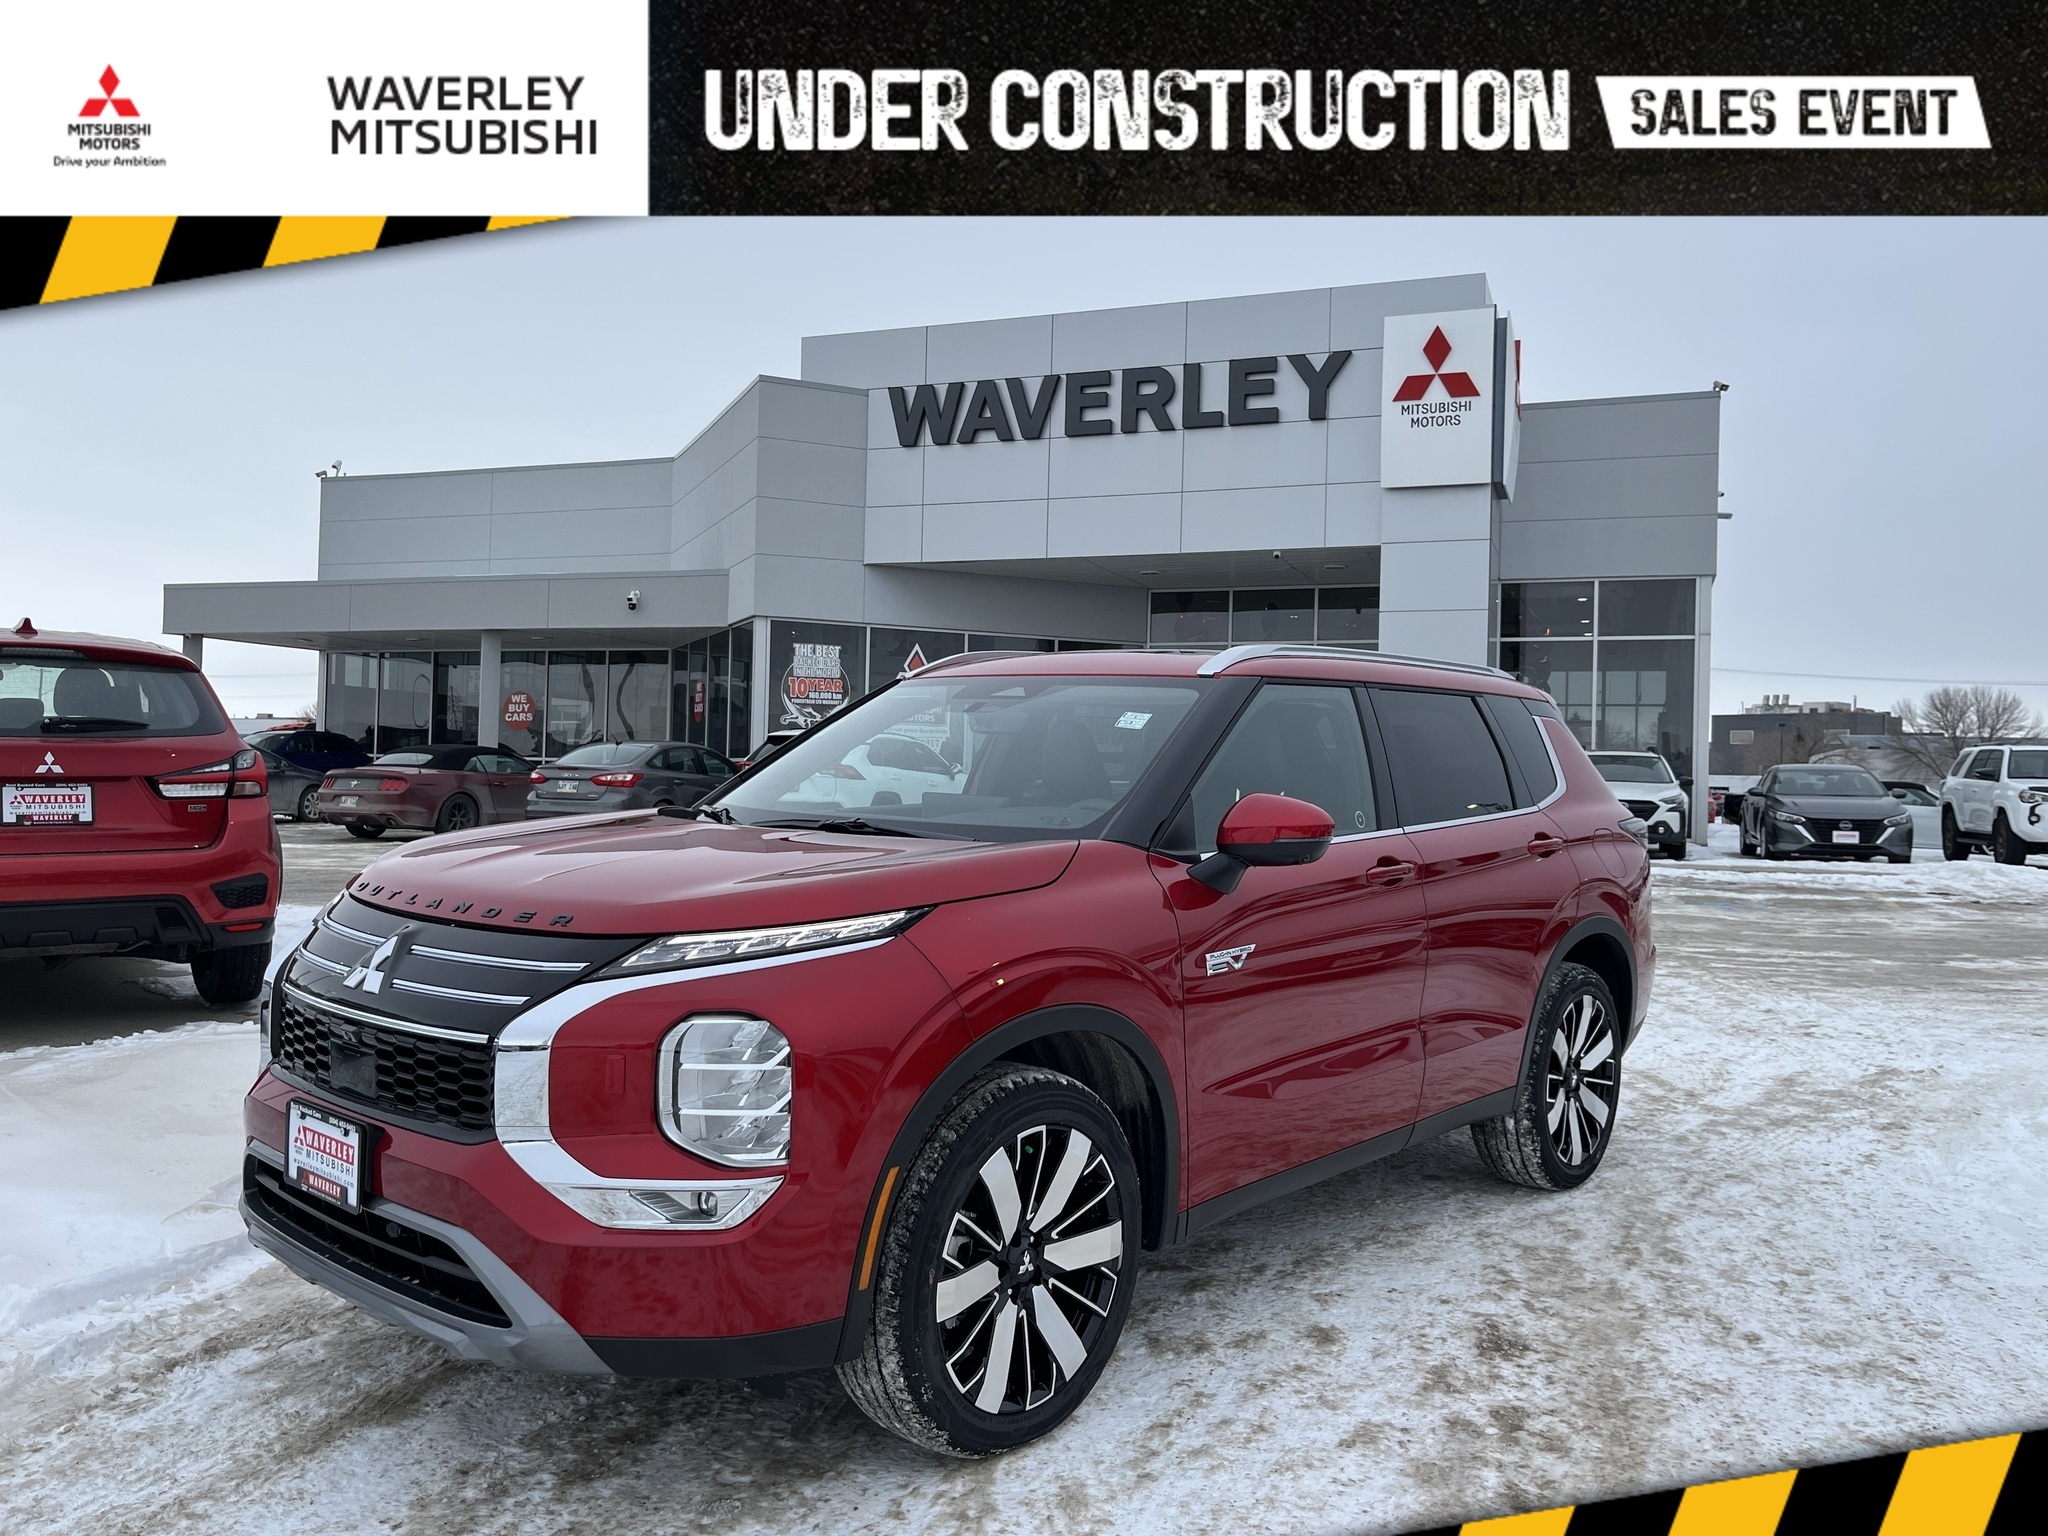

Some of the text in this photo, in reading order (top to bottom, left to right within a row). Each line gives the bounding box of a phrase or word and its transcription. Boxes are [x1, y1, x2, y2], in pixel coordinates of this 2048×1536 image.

[888, 350, 1352, 447] WAVERLEY
[1401, 400, 1472, 416] MITSUBISHI
[1410, 414, 1461, 428] MOTORS
[793, 643, 842, 658] THE BEST
[794, 656, 841, 668] BACKED CARS
[816, 668, 841, 678] WORLD
[789, 677, 843, 698] 10 YEAR
[511, 694, 527, 703] WE
[508, 703, 530, 712] BUY
[505, 713, 533, 722] CARS
[905, 714, 935, 722] OTORS
[24, 795, 85, 803] WAVERLEY
[356, 882, 574, 927] OUTLANDER
[1232, 946, 1252, 954] HYBRID
[1206, 952, 1248, 976] EV
[305, 1129, 354, 1163] WAVERLEY
[306, 1149, 354, 1177] MITSUBISHI
[309, 1174, 340, 1197] WAVERLEY
